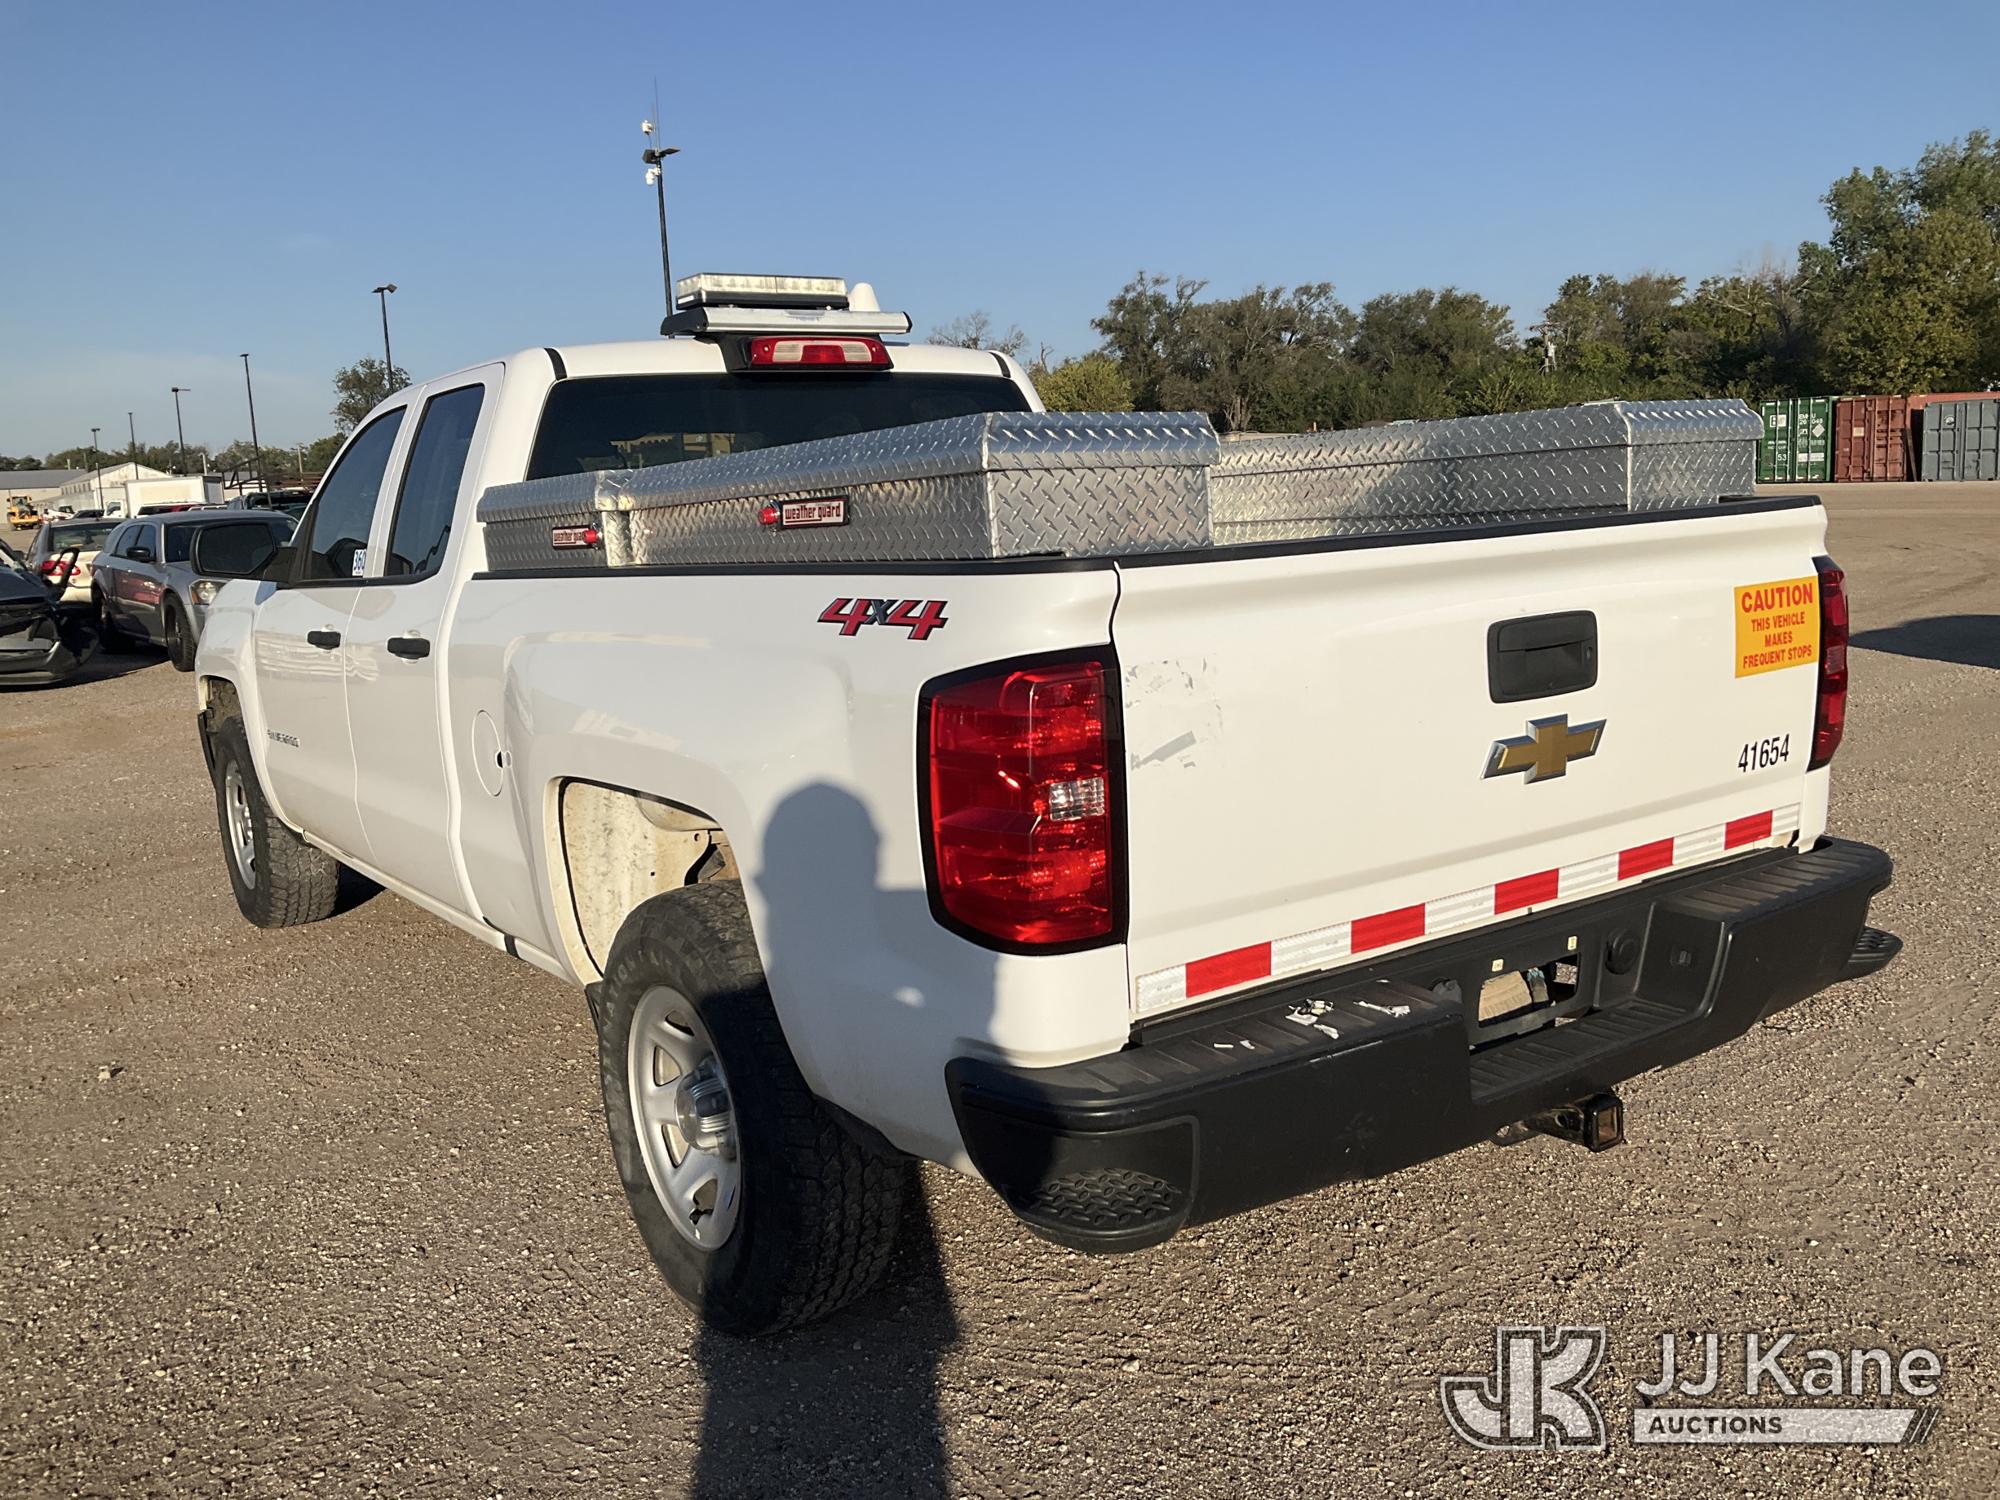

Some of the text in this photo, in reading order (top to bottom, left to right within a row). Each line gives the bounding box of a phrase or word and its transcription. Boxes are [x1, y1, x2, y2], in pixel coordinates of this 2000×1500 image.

[784, 502, 841, 520] weather guard
[1741, 582, 1813, 614] CAUTION
[1751, 611, 1806, 633] THIS VEHICLE
[1764, 630, 1793, 648] MAKES
[1743, 644, 1812, 669] FREQUENT STOPS
[1737, 733, 1791, 773] 41654
